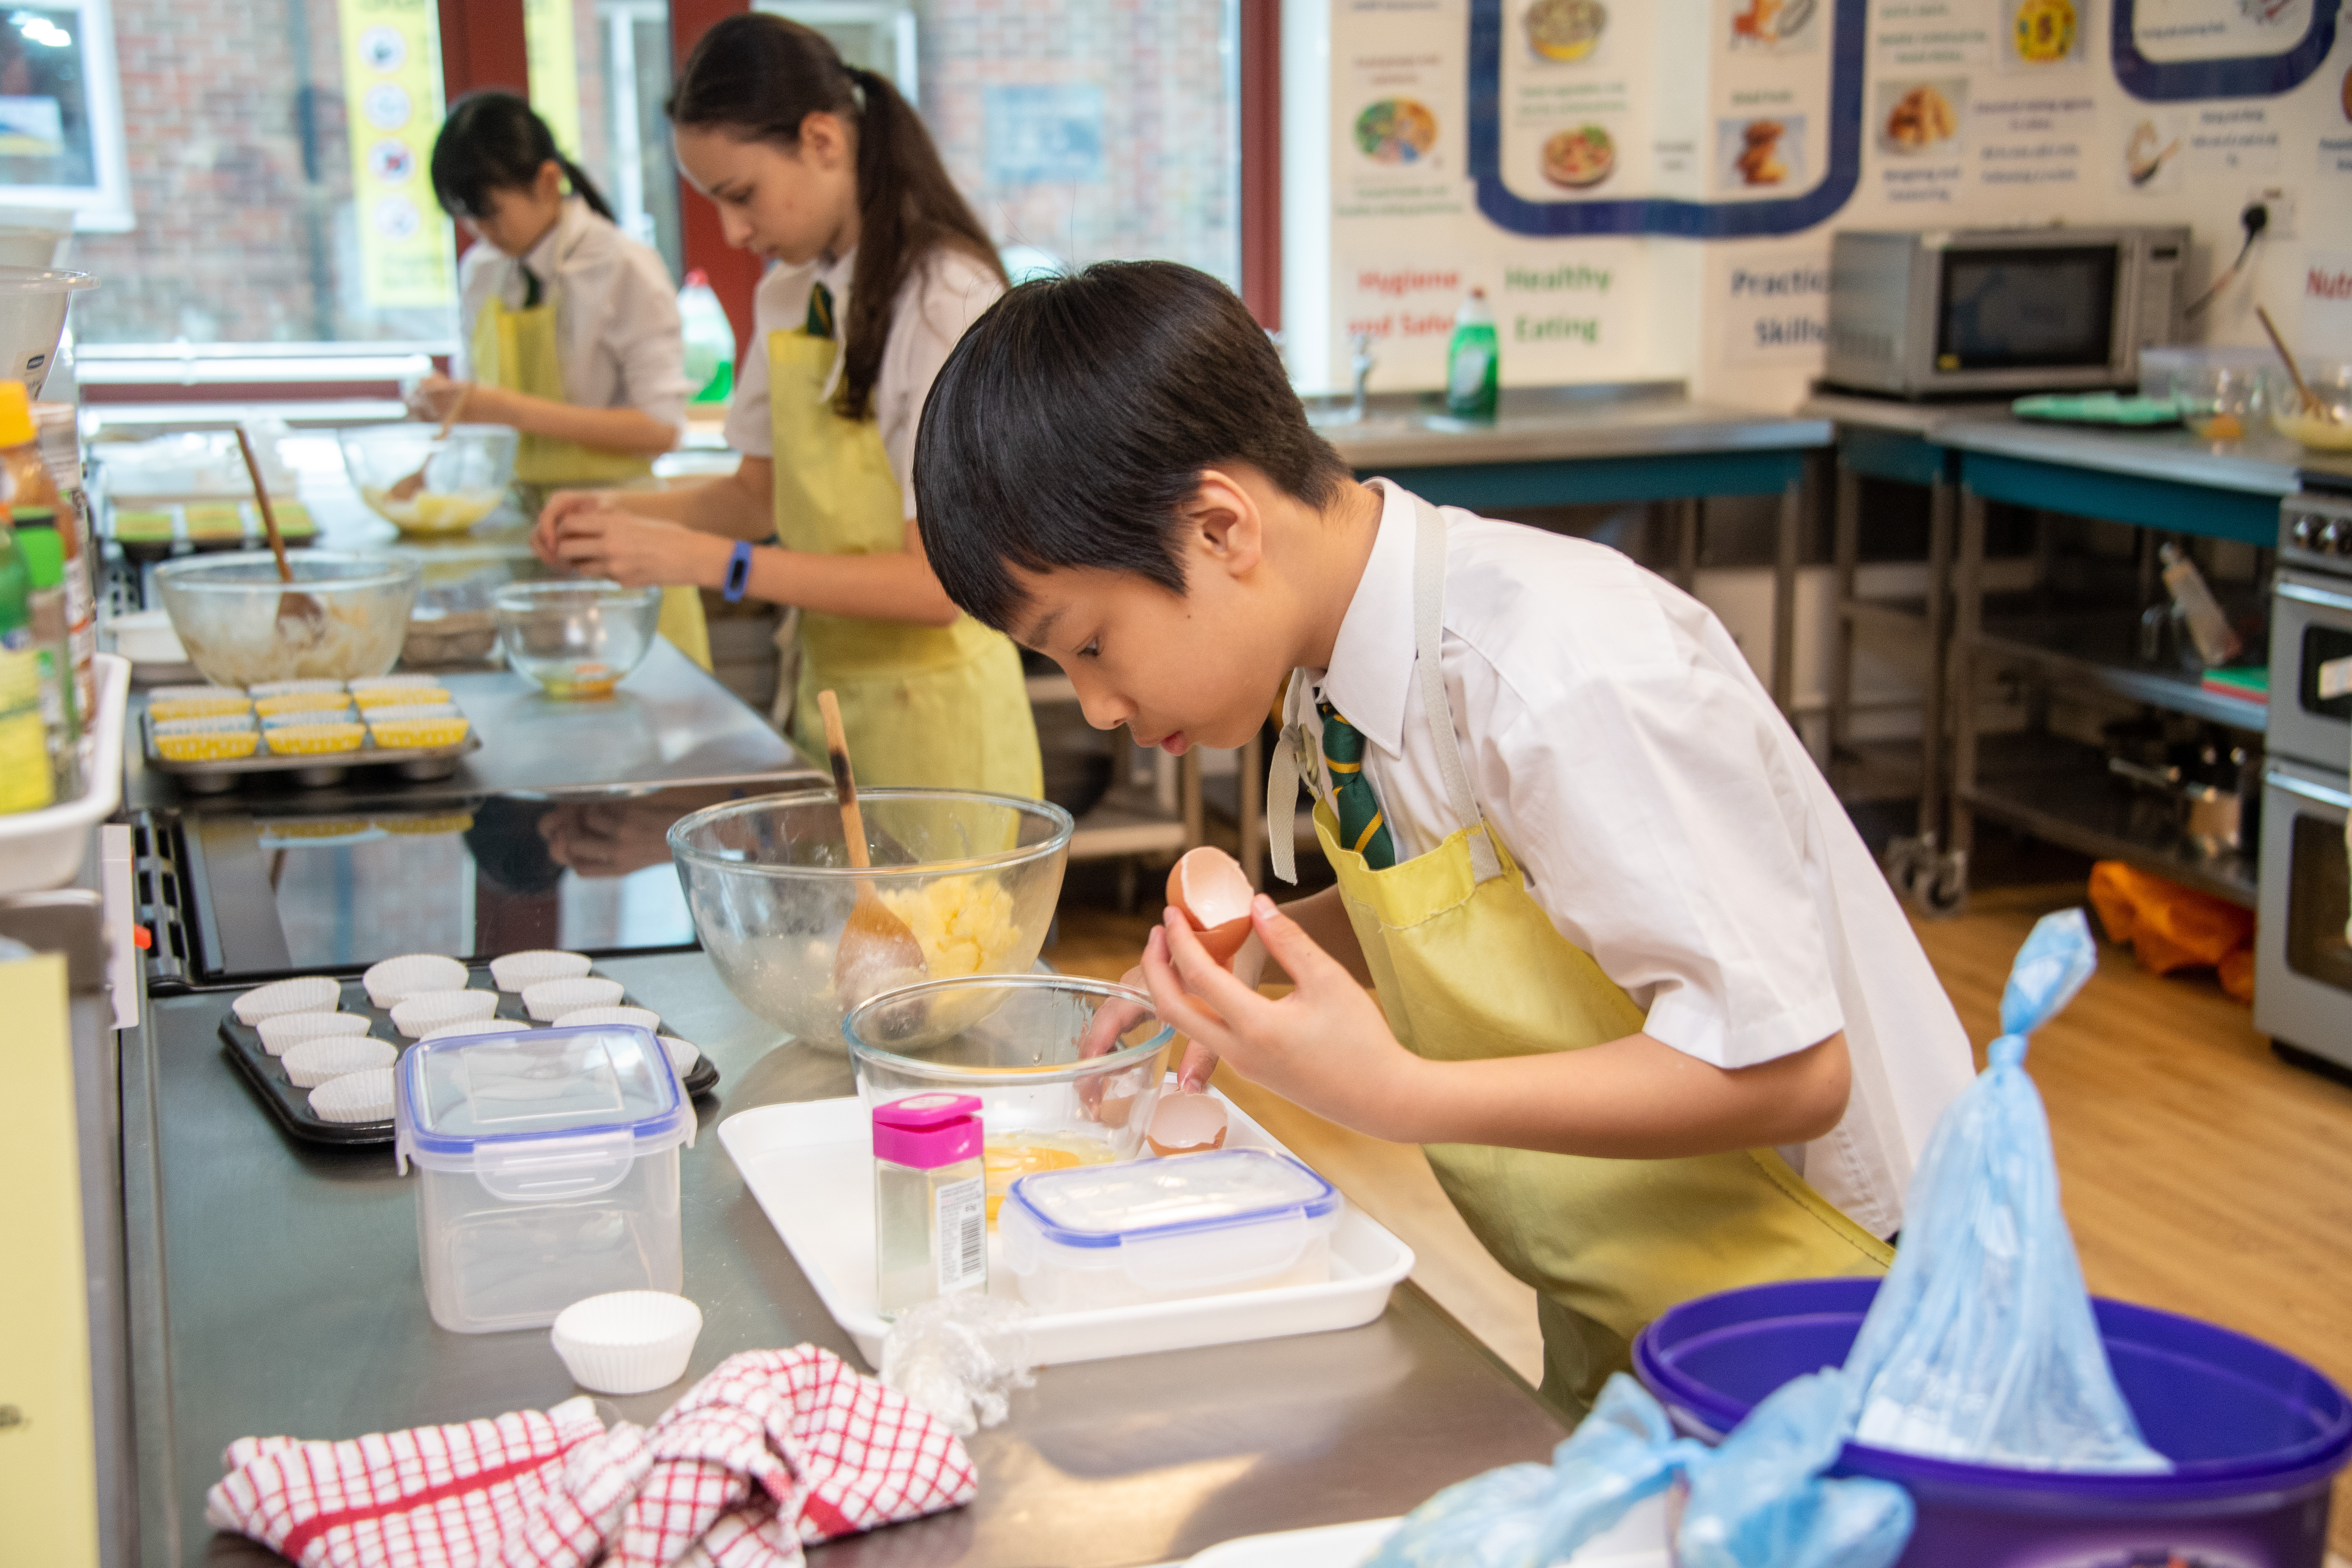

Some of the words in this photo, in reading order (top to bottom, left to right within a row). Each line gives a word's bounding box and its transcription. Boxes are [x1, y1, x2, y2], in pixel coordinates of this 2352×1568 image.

[1357, 271, 1458, 297] Hygiene
[1504, 266, 1610, 294] Healthy
[1730, 269, 1828, 296] Practic
[1348, 315, 1390, 336] and
[1515, 315, 1598, 344] Eating
